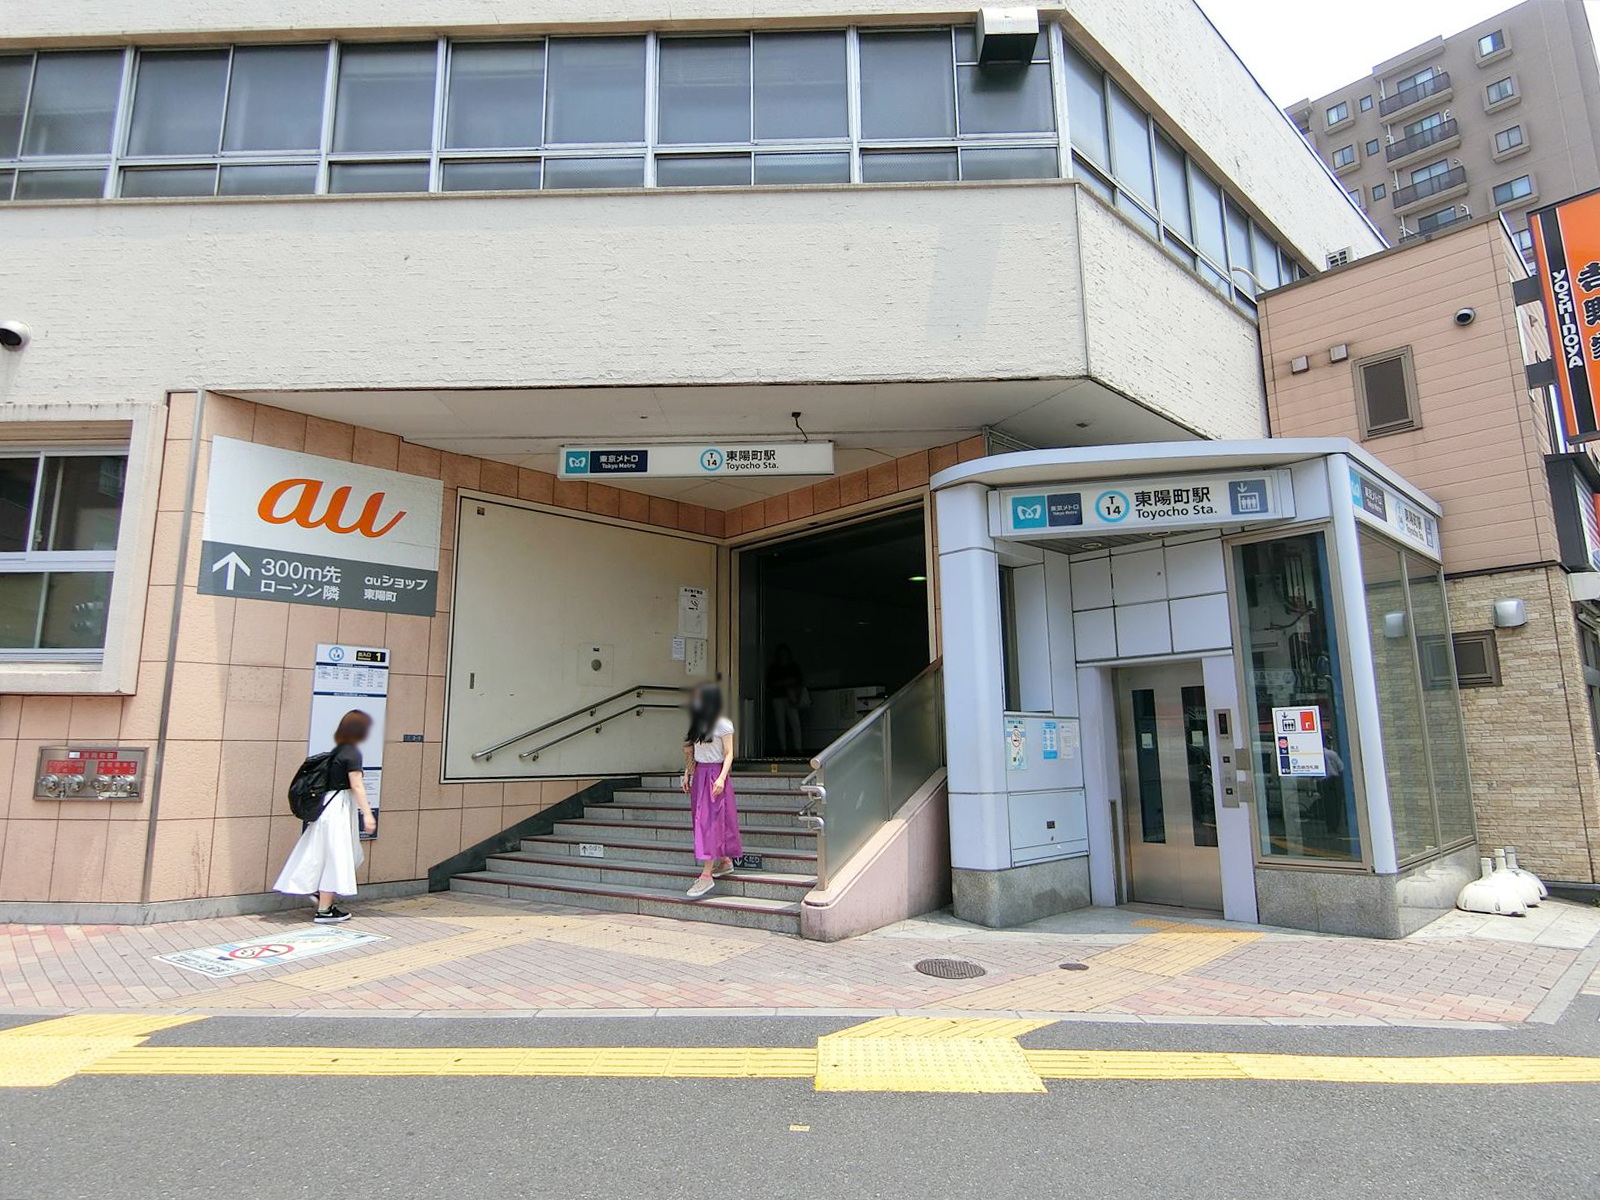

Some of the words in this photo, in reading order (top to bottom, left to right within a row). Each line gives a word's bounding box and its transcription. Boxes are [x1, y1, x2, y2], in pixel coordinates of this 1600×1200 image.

[599, 454, 639, 463] 東京メトロ
[725, 449, 776, 461] 東陽町駅
[706, 459, 717, 467] 14
[725, 462, 761, 471] Toyocho
[763, 461, 779, 469] Sta.
[1107, 495, 1116, 505] T
[1133, 486, 1211, 507] 東陽町駅
[257, 478, 407, 538] au
[1105, 505, 1122, 517] 14
[1135, 505, 1189, 520] Toyocho
[1193, 503, 1218, 515] Sta.
[261, 558, 342, 583] 300m先
[364, 575, 428, 591] auショップ
[363, 589, 397, 602] 東陽町
[375, 652, 382, 662] 1
